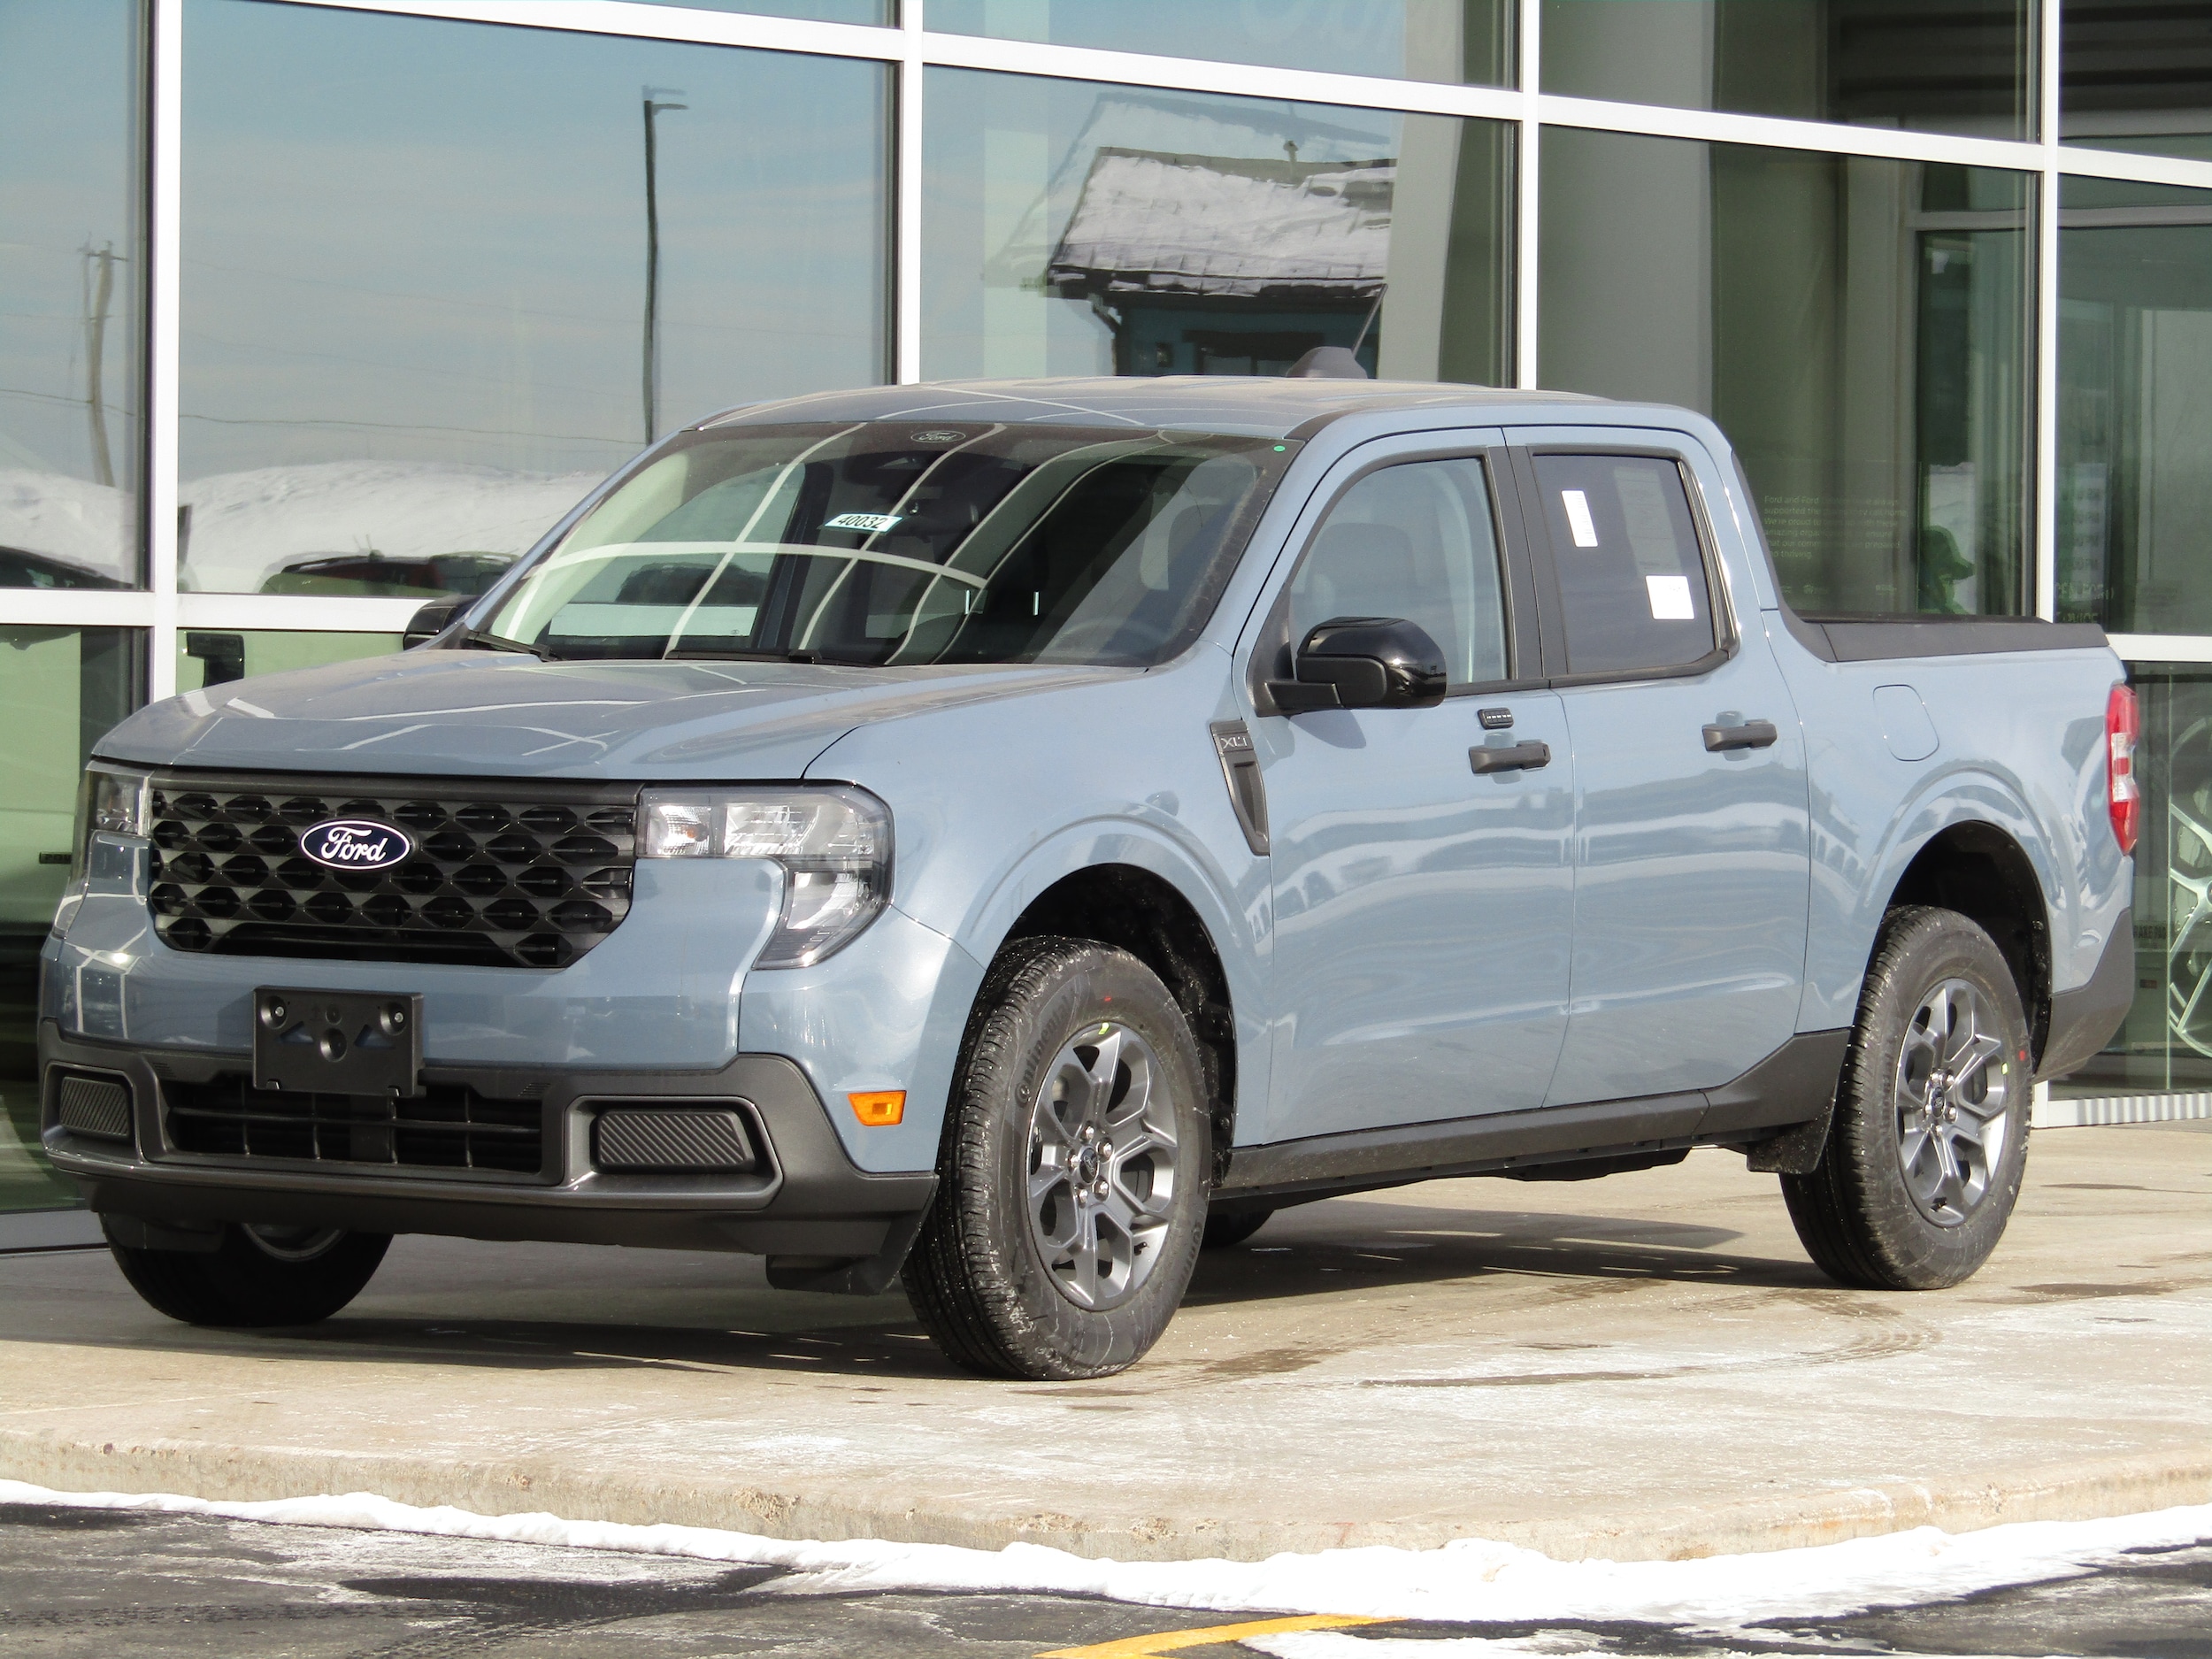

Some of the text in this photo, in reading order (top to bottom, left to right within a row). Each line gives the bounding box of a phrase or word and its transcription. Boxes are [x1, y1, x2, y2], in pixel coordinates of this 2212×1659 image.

[838, 515, 887, 529] 40032
[1220, 736, 1248, 749] XLT
[320, 826, 388, 862] Ford
